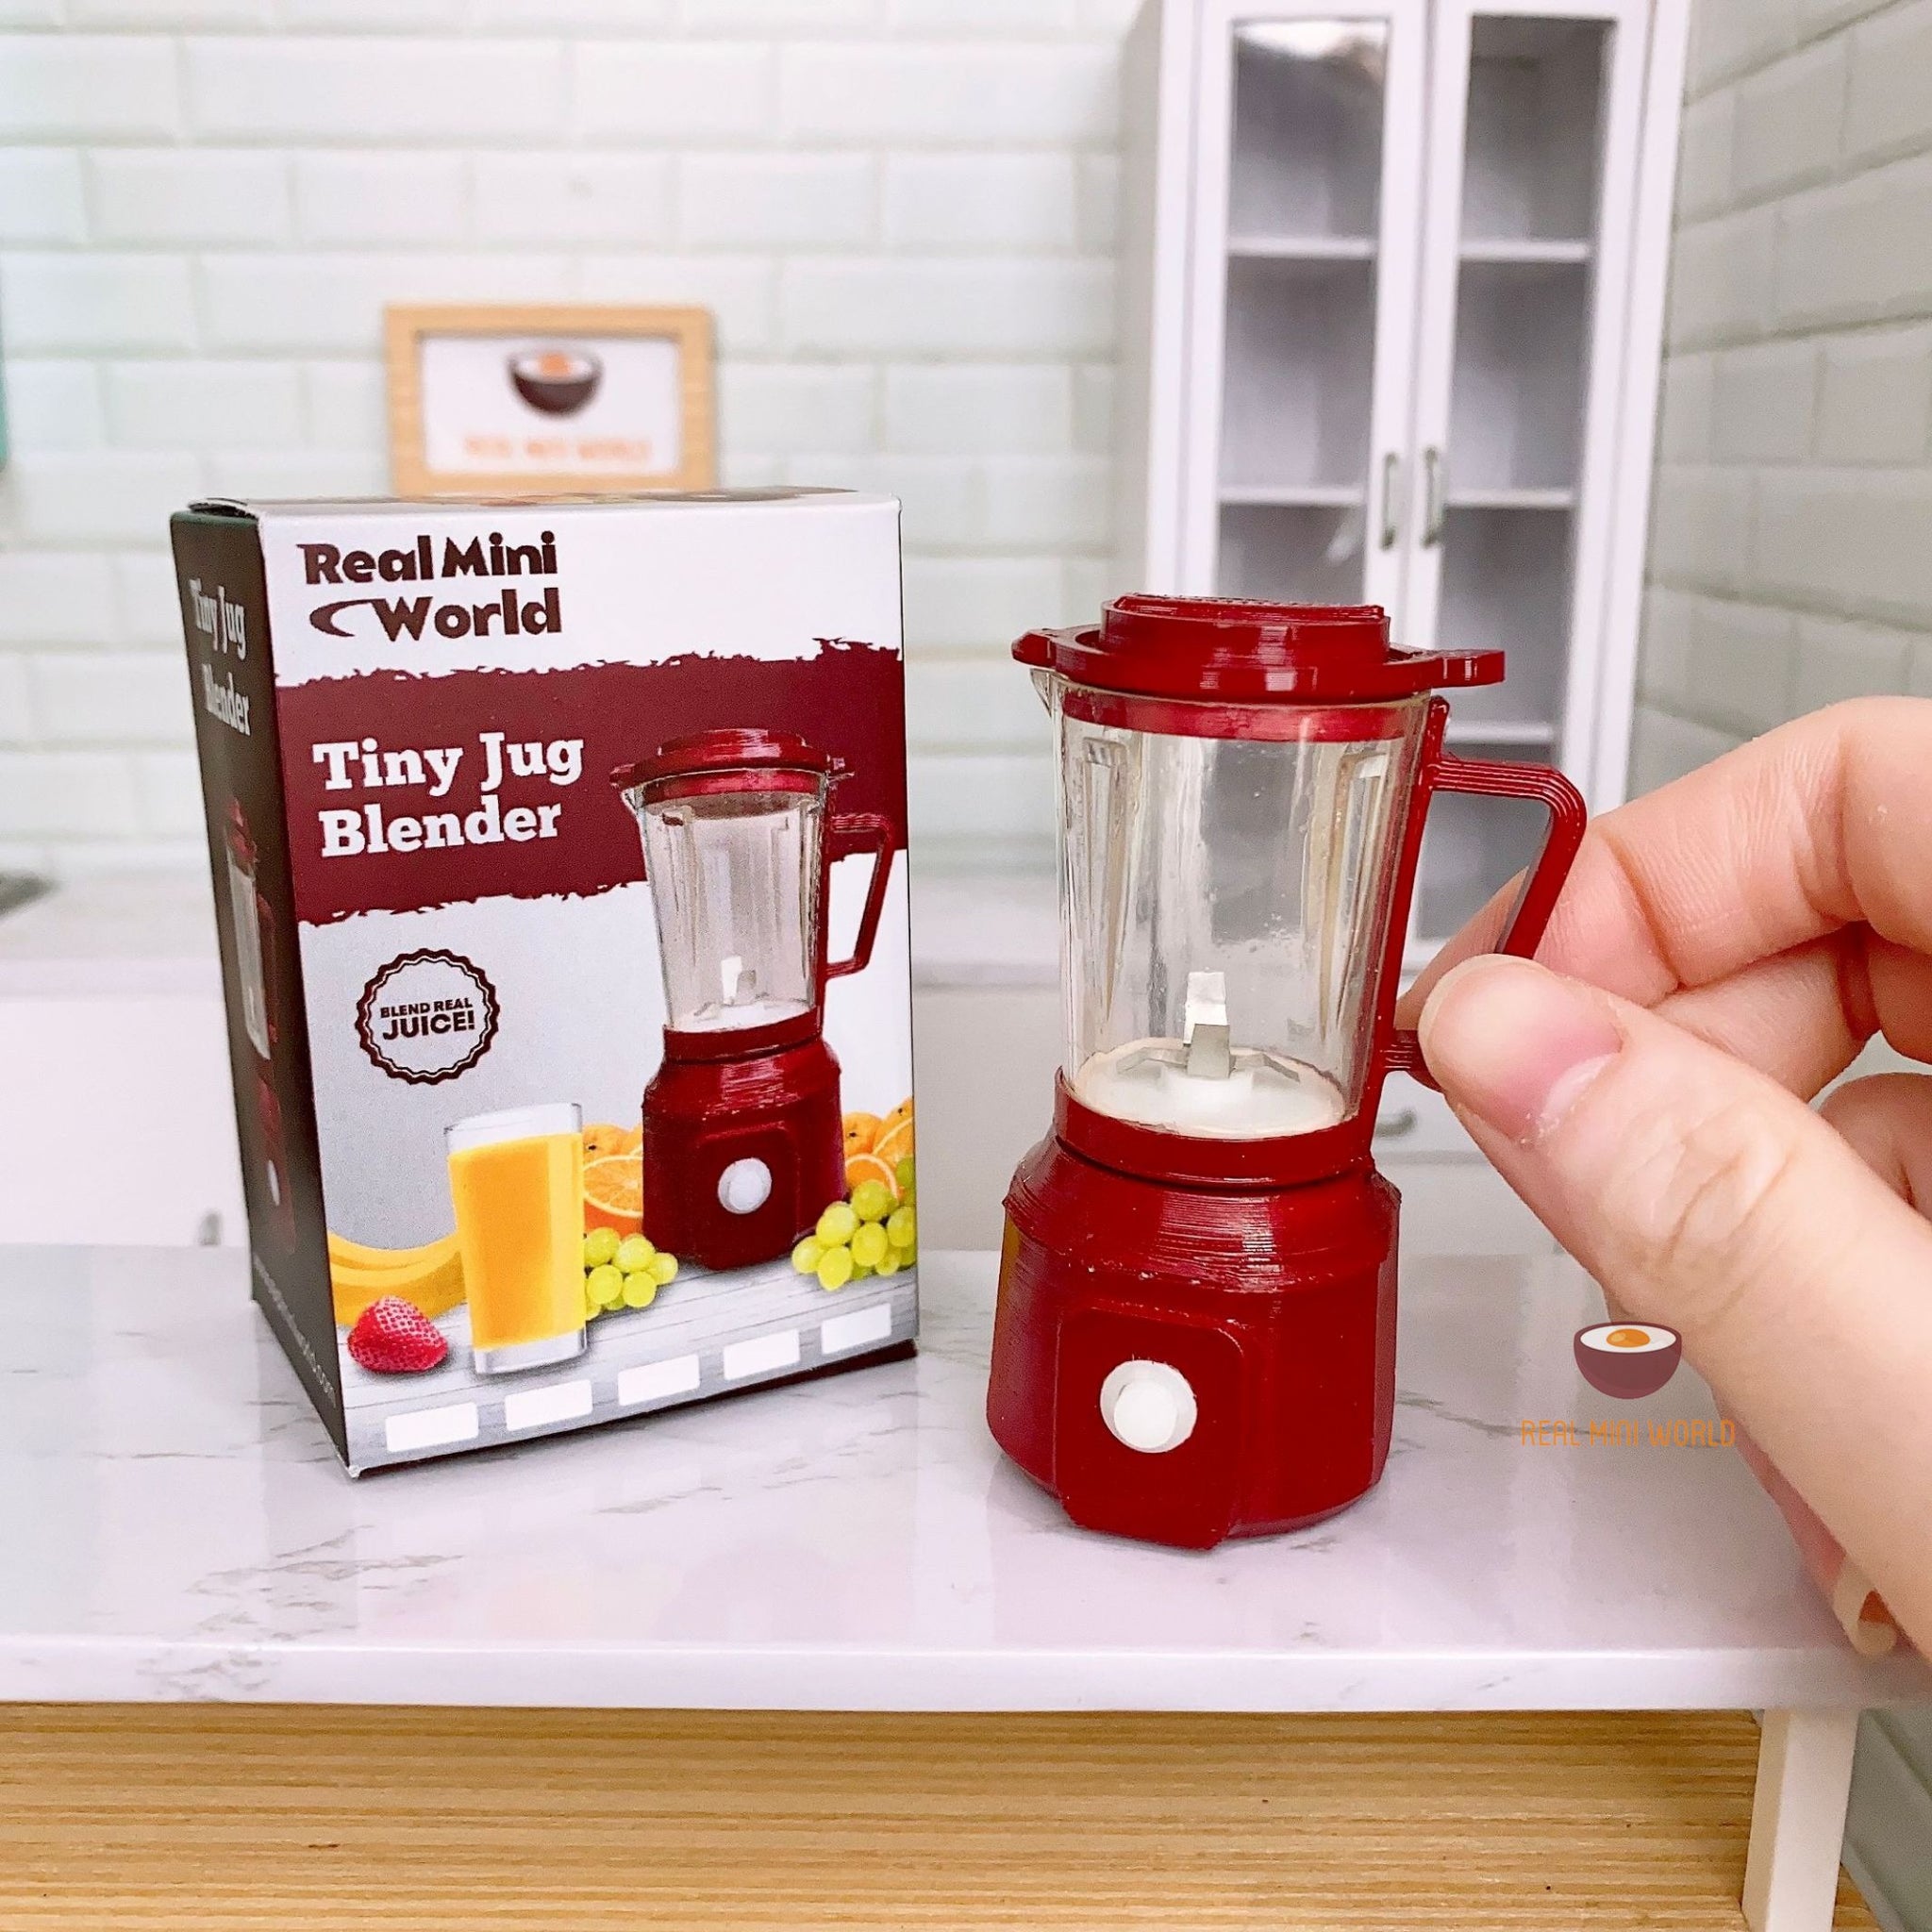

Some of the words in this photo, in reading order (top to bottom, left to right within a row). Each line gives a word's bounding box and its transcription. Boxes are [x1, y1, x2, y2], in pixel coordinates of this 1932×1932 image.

[296, 535, 434, 585] Real
[441, 530, 558, 578] Mini
[189, 577, 219, 651] Tiny
[218, 585, 247, 660] Jug
[309, 587, 562, 641] World
[201, 663, 251, 737] Blender
[312, 737, 463, 797] Tiny
[479, 731, 584, 791] Jug
[318, 794, 562, 858] Blender
[380, 1002, 430, 1019] BLEND
[433, 997, 474, 1012] REAL
[382, 1009, 475, 1040] JUICE!
